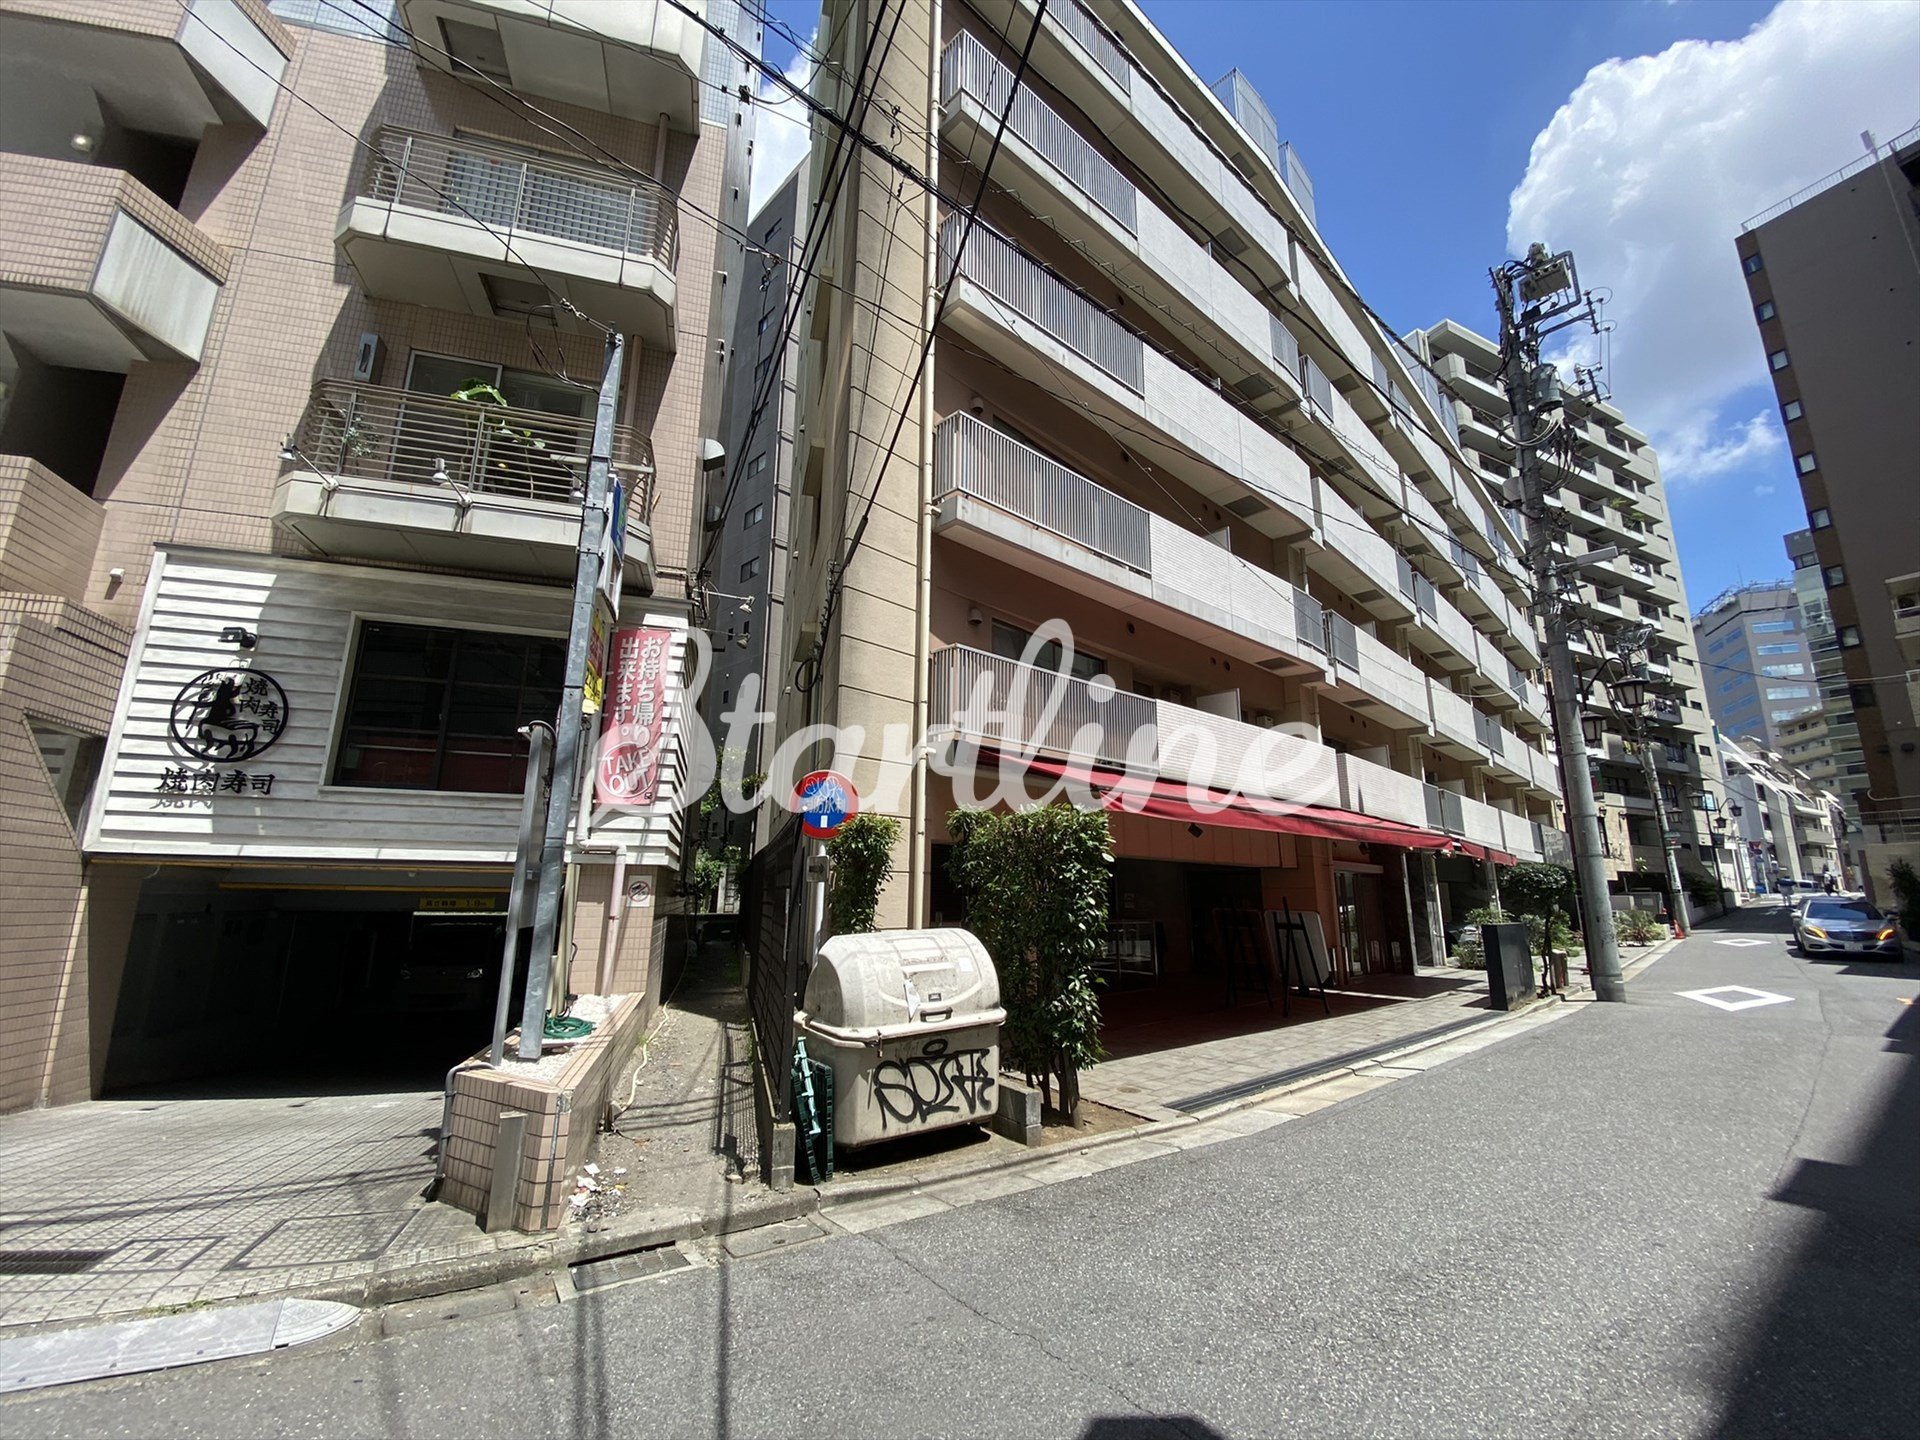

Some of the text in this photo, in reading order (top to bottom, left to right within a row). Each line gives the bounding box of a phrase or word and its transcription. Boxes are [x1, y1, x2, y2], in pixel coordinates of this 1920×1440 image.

[614, 637, 639, 737] 出来ます。
[632, 636, 663, 748] お持ち帰り
[603, 747, 653, 775] TAKE
[154, 767, 276, 796] 焼肉寿司
[609, 768, 650, 795] OUT
